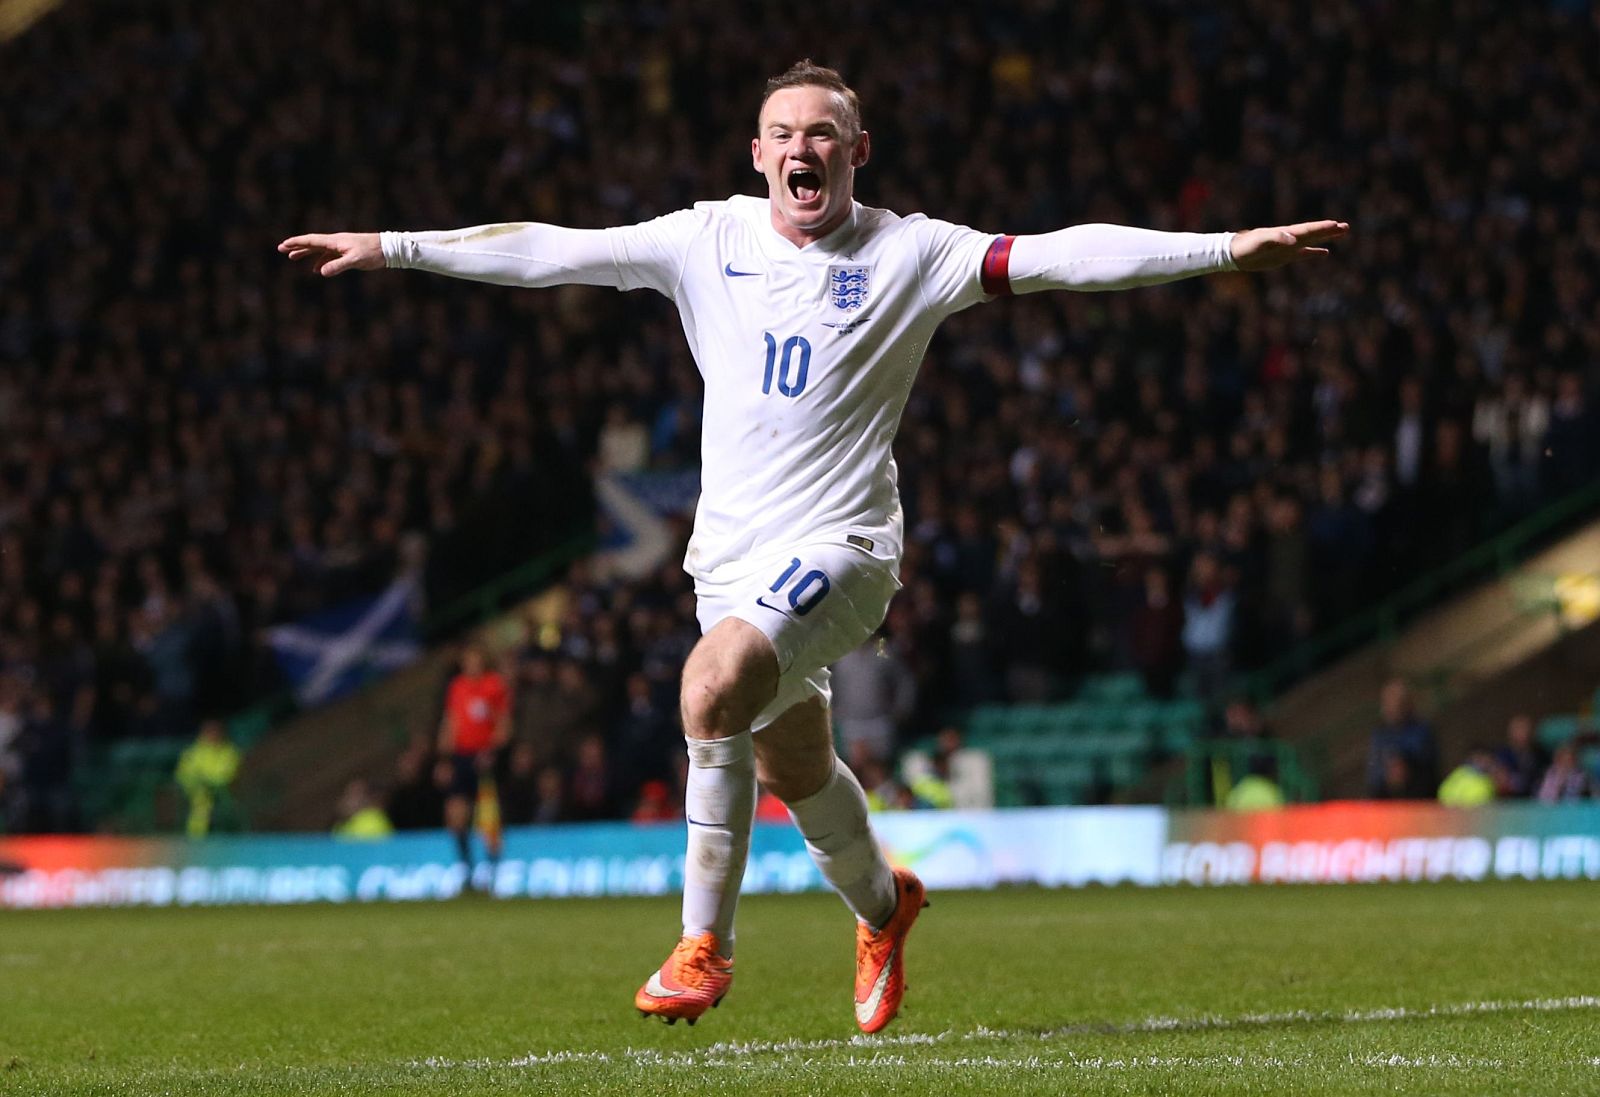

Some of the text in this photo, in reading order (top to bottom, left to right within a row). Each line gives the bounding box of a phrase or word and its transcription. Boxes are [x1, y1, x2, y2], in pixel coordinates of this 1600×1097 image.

[762, 331, 811, 397] 10
[769, 557, 830, 616] 10
[1162, 841, 1256, 886] FOR
